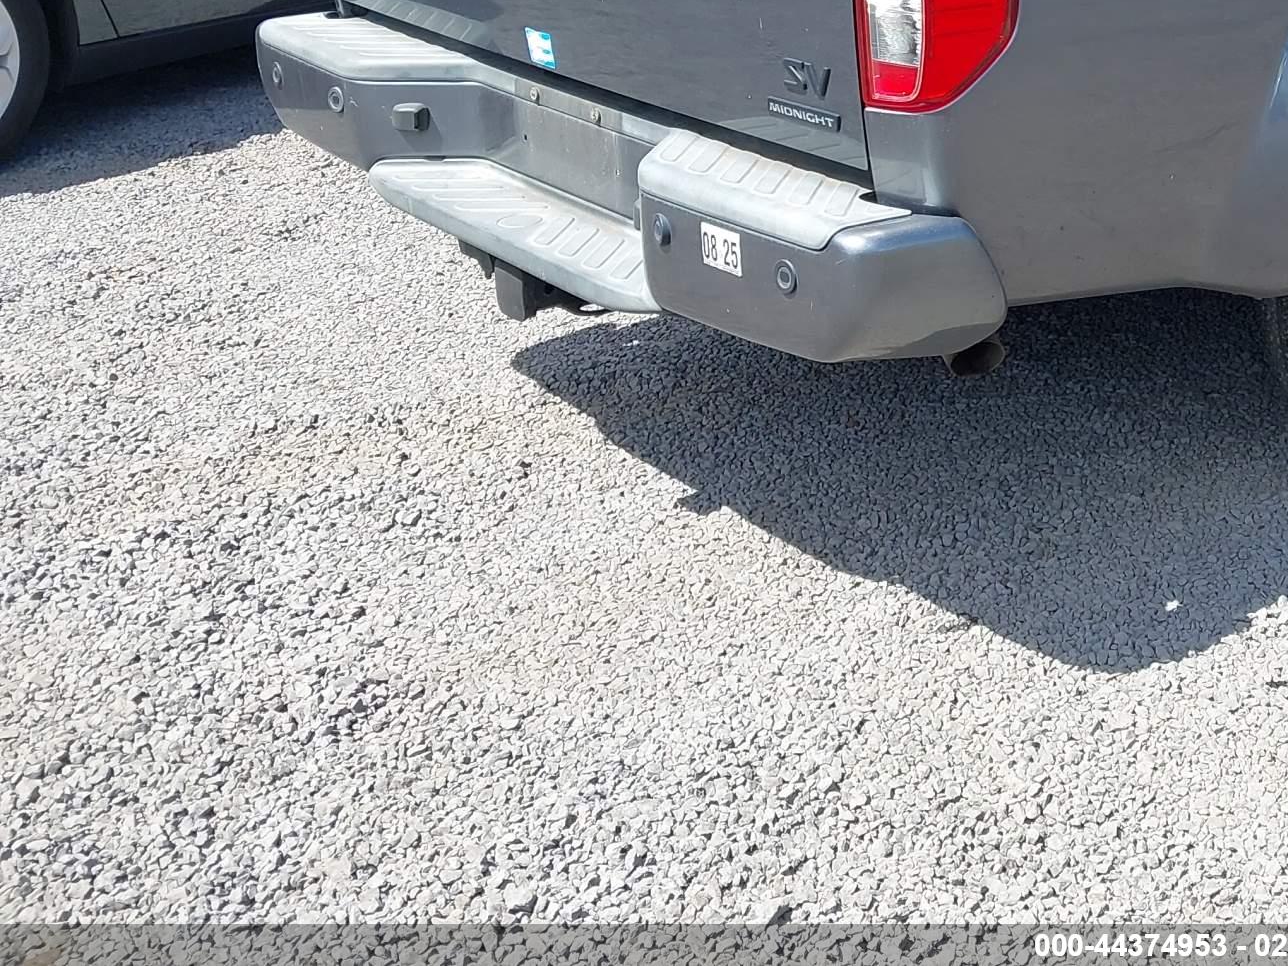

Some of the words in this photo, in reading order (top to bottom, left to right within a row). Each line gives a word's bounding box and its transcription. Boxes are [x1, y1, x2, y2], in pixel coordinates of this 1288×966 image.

[783, 57, 831, 101] SV
[769, 101, 834, 128] MIDNIGHT
[703, 231, 717, 260] 08
[723, 238, 738, 270] 25
